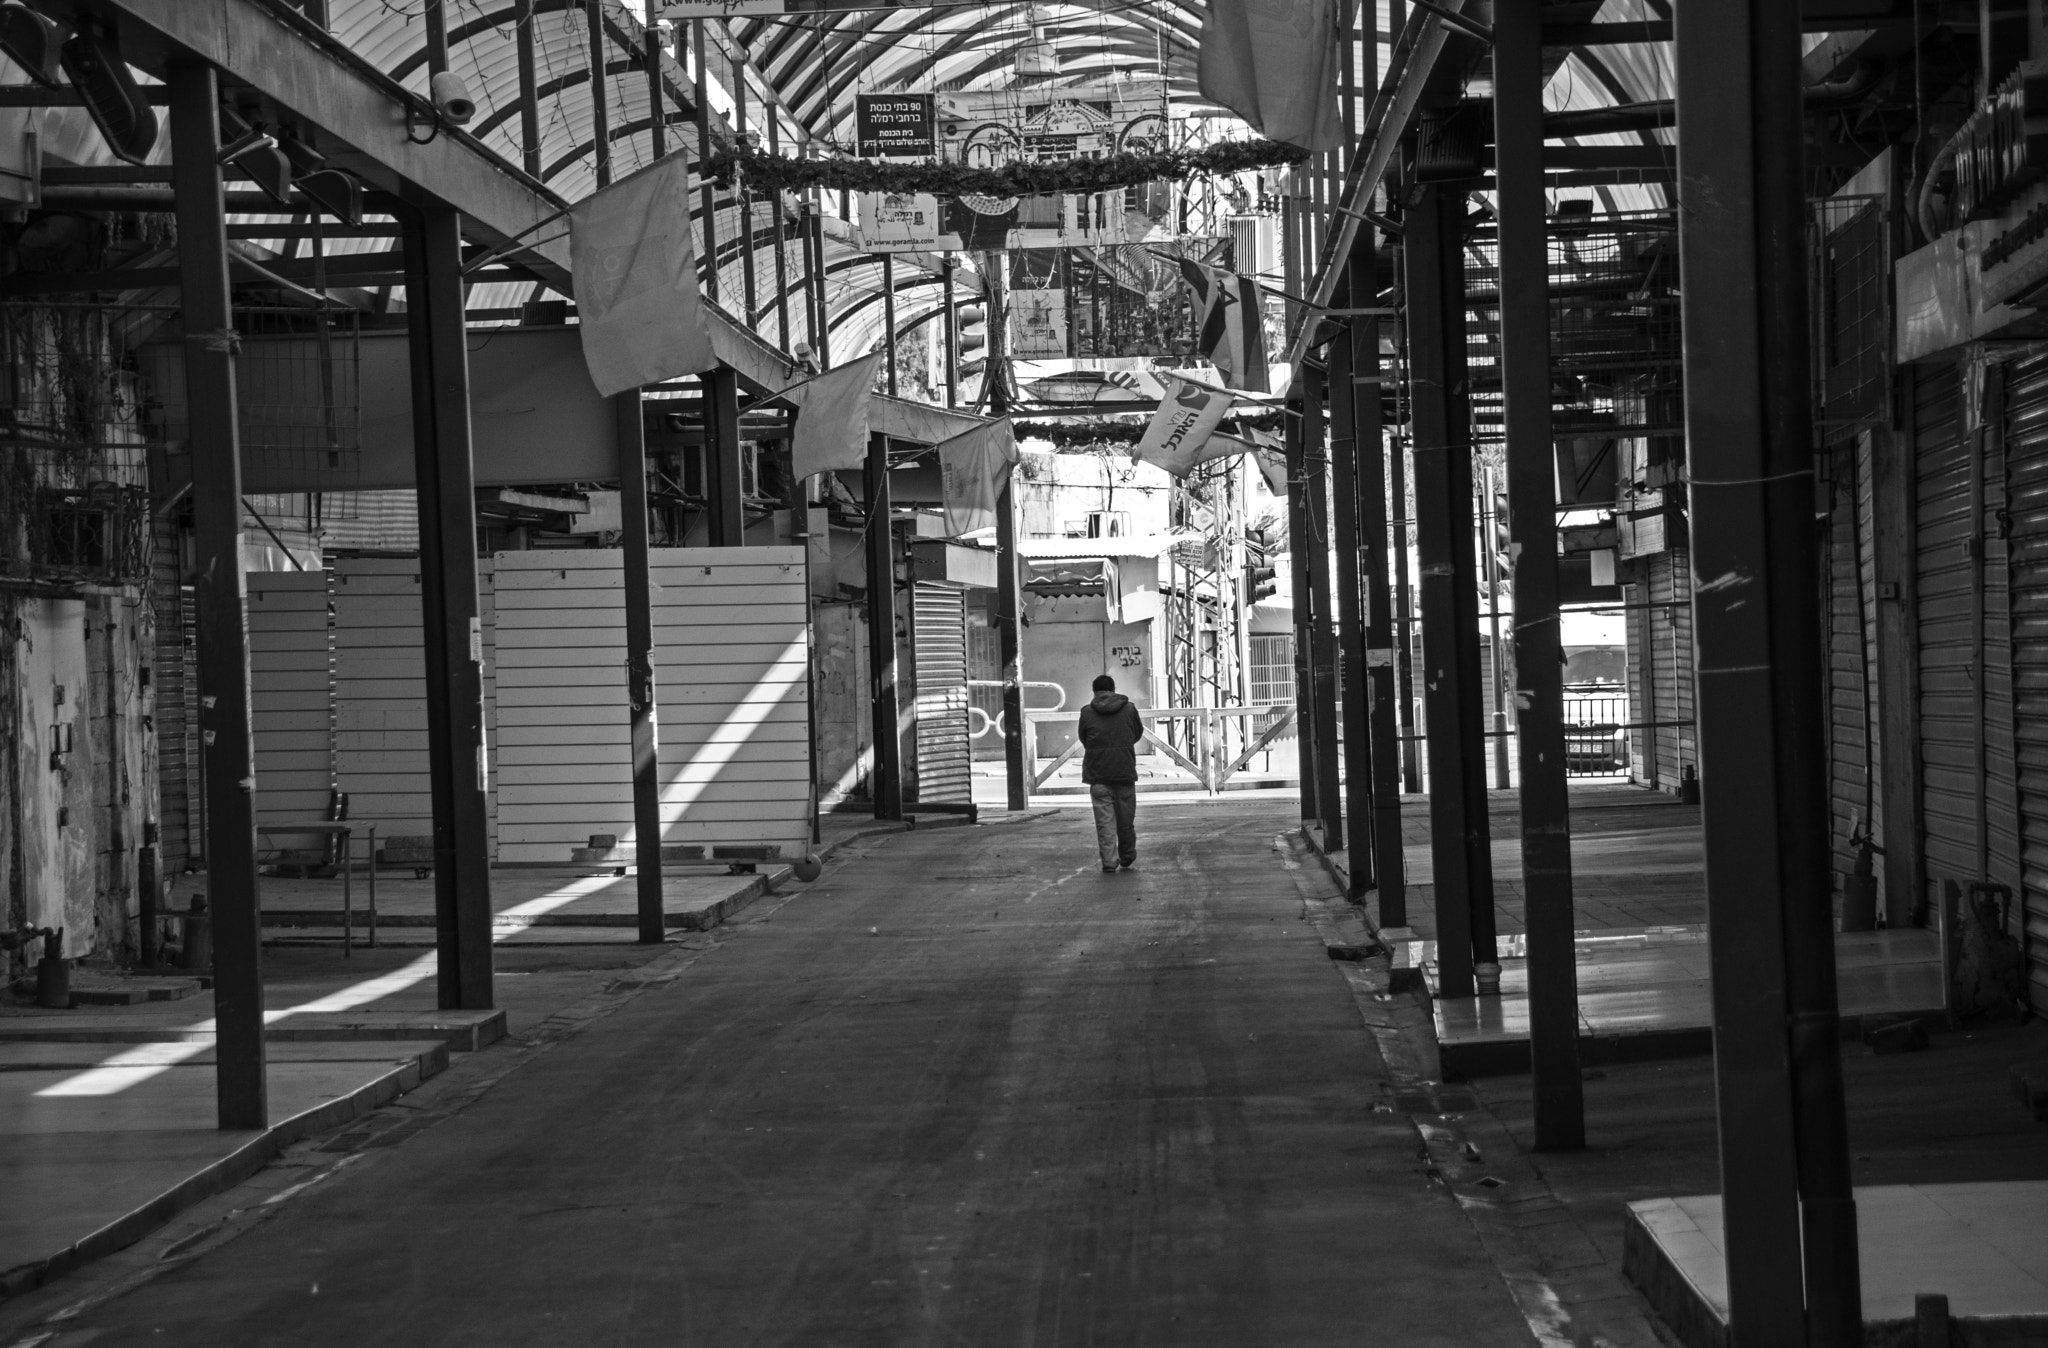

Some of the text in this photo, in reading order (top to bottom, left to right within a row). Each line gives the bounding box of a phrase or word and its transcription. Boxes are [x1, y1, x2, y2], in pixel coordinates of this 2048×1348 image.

[869, 102, 921, 112] 90 בתי כנסת
[870, 113, 921, 123] ברחבי רמלה
[879, 129, 901, 137] הכנסת
[896, 137, 913, 146] שלום
[874, 238, 935, 246] www.goramla.com
[1160, 412, 1200, 452] האוכל
